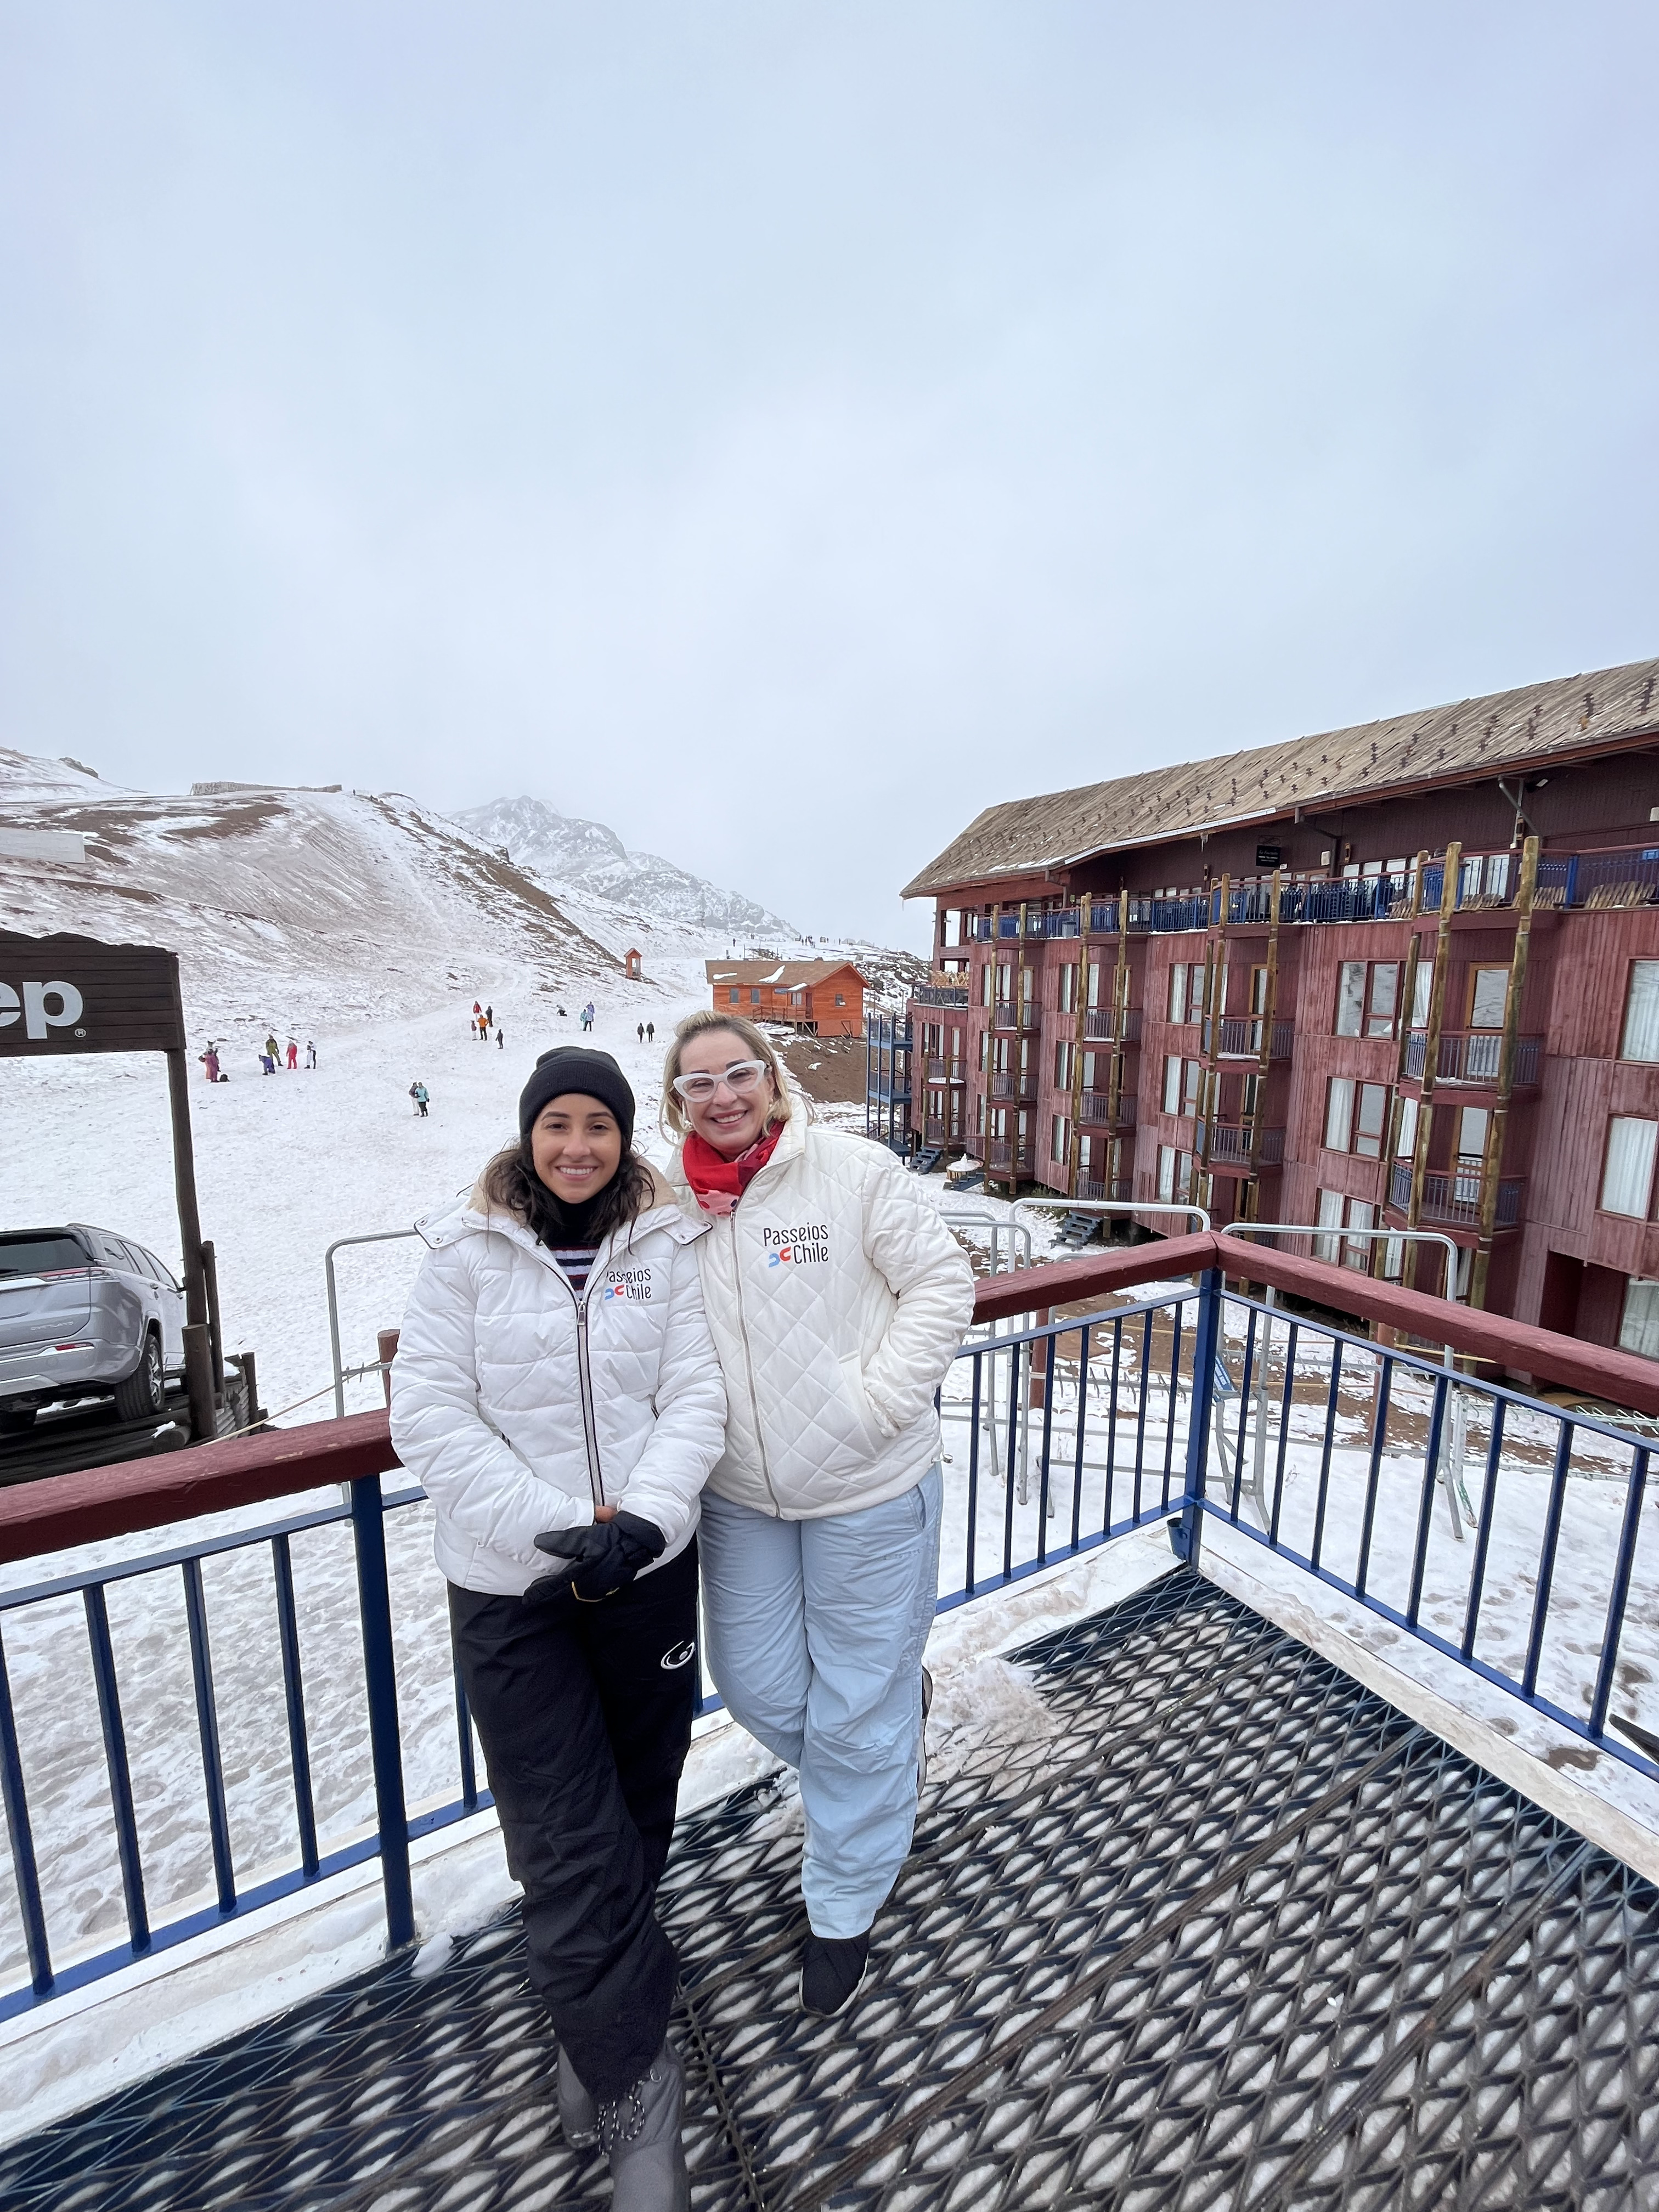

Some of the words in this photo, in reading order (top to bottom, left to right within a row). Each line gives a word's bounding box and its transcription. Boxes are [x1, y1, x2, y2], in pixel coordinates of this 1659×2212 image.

[763, 1222, 828, 1246] Passeios
[793, 1242, 829, 1264] Chile
[606, 1267, 651, 1284] asseios
[626, 1283, 652, 1300] Chile
